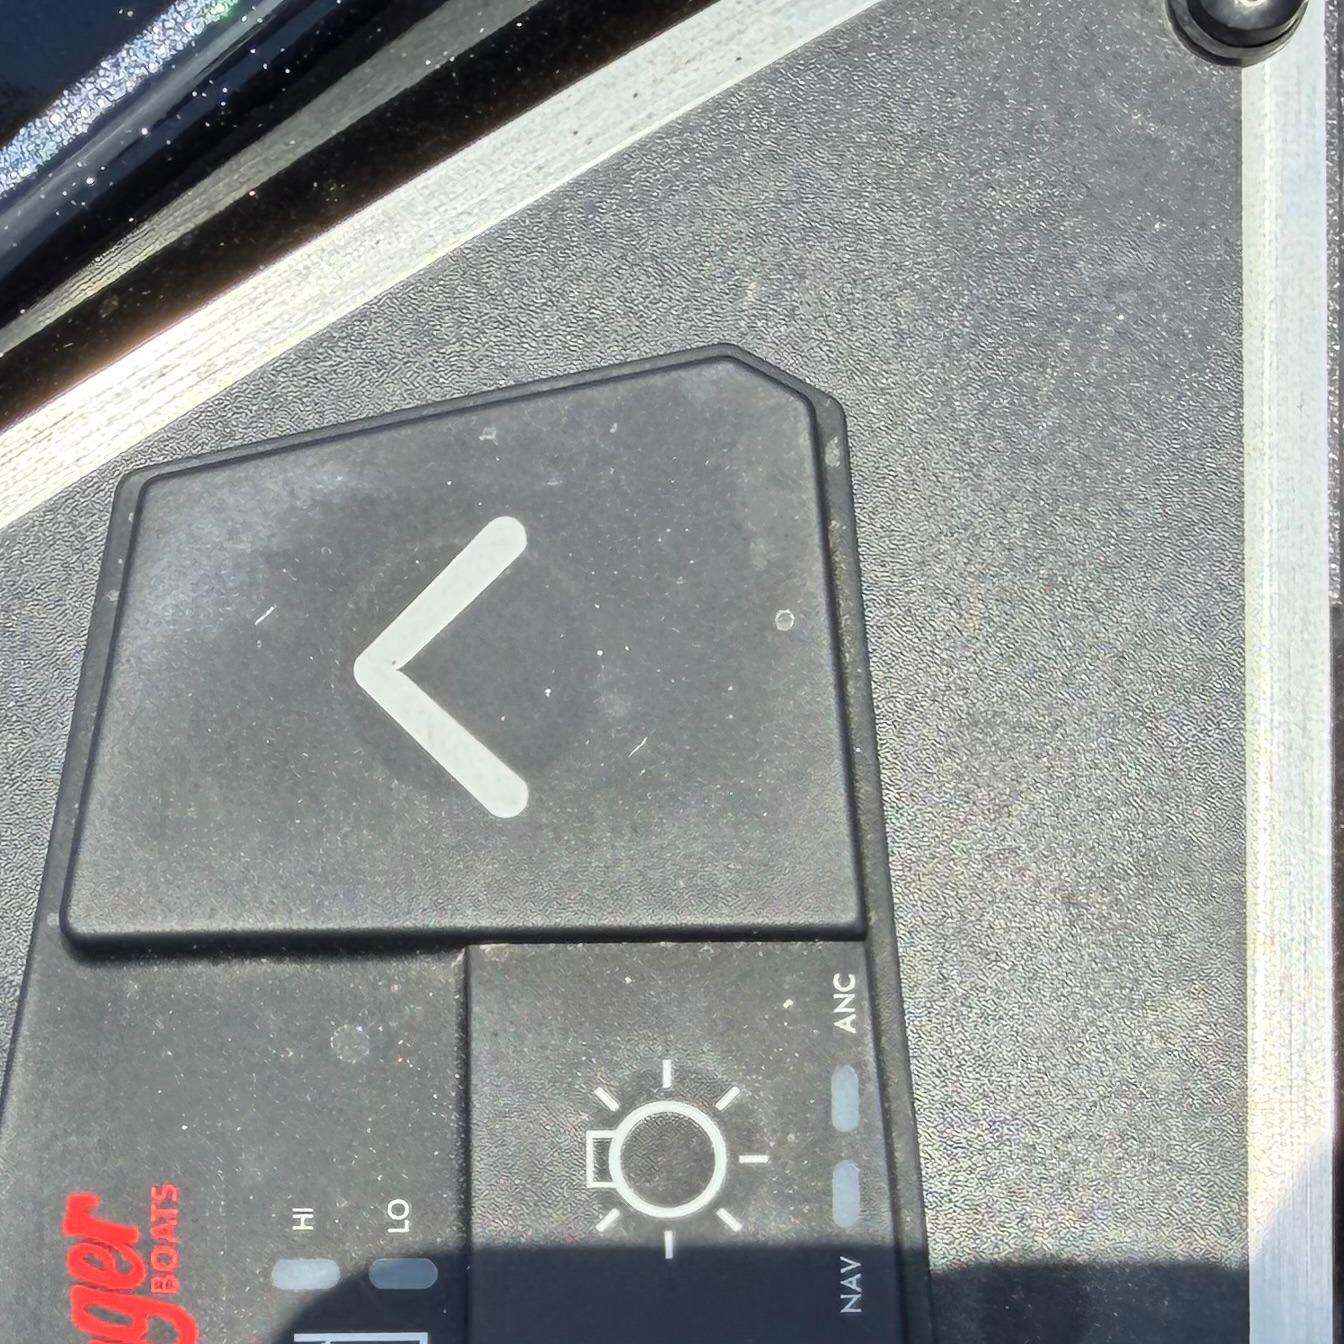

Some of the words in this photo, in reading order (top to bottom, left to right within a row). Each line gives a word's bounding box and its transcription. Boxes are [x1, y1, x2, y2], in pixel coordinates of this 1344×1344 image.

[832, 973, 857, 1034] ANC
[150, 1183, 179, 1294] BOATS
[291, 1207, 314, 1231] HI
[387, 1198, 410, 1233] LO
[839, 1256, 862, 1313] NAV
